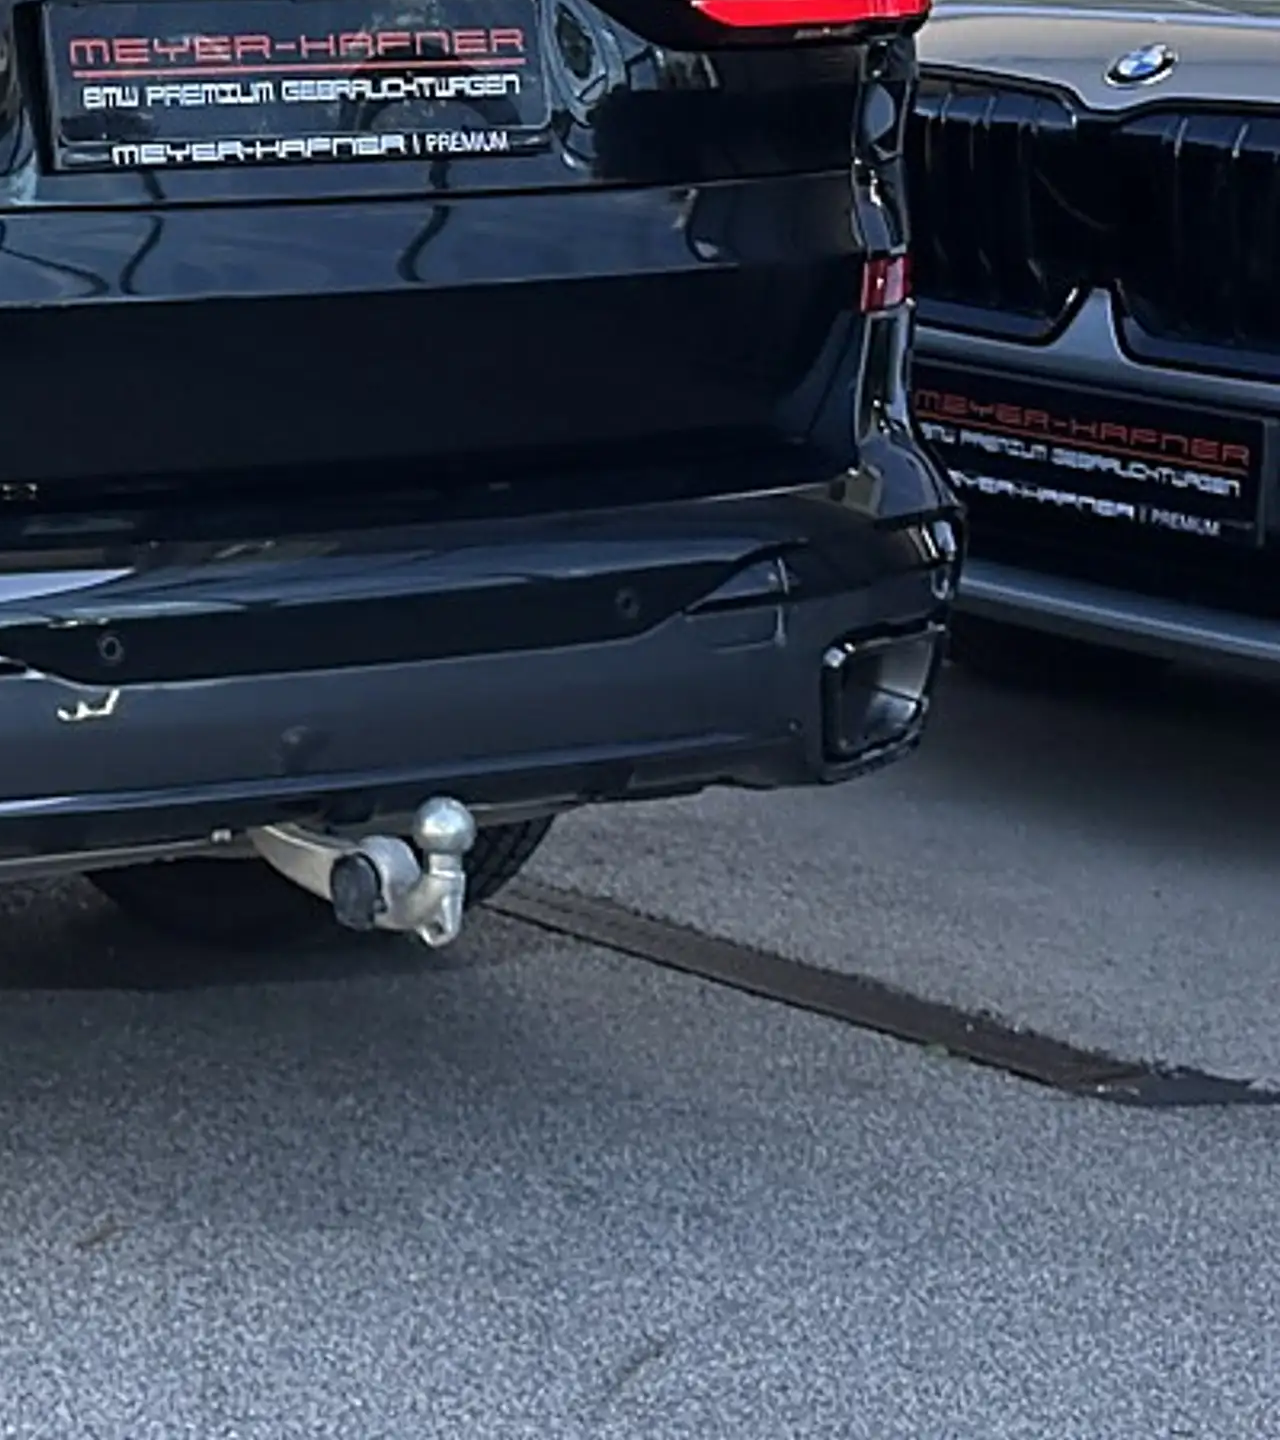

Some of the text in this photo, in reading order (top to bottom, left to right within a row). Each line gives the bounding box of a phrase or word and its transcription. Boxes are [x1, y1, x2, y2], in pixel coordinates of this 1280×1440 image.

[69, 27, 526, 65] MEYER-HAFNER
[83, 73, 521, 109] BMW PREMIUM GEBRAUCHTWAGEN
[111, 130, 510, 166] MEYER-HAFNER PREMIUM
[915, 388, 1251, 468] MEYER-HAFNER
